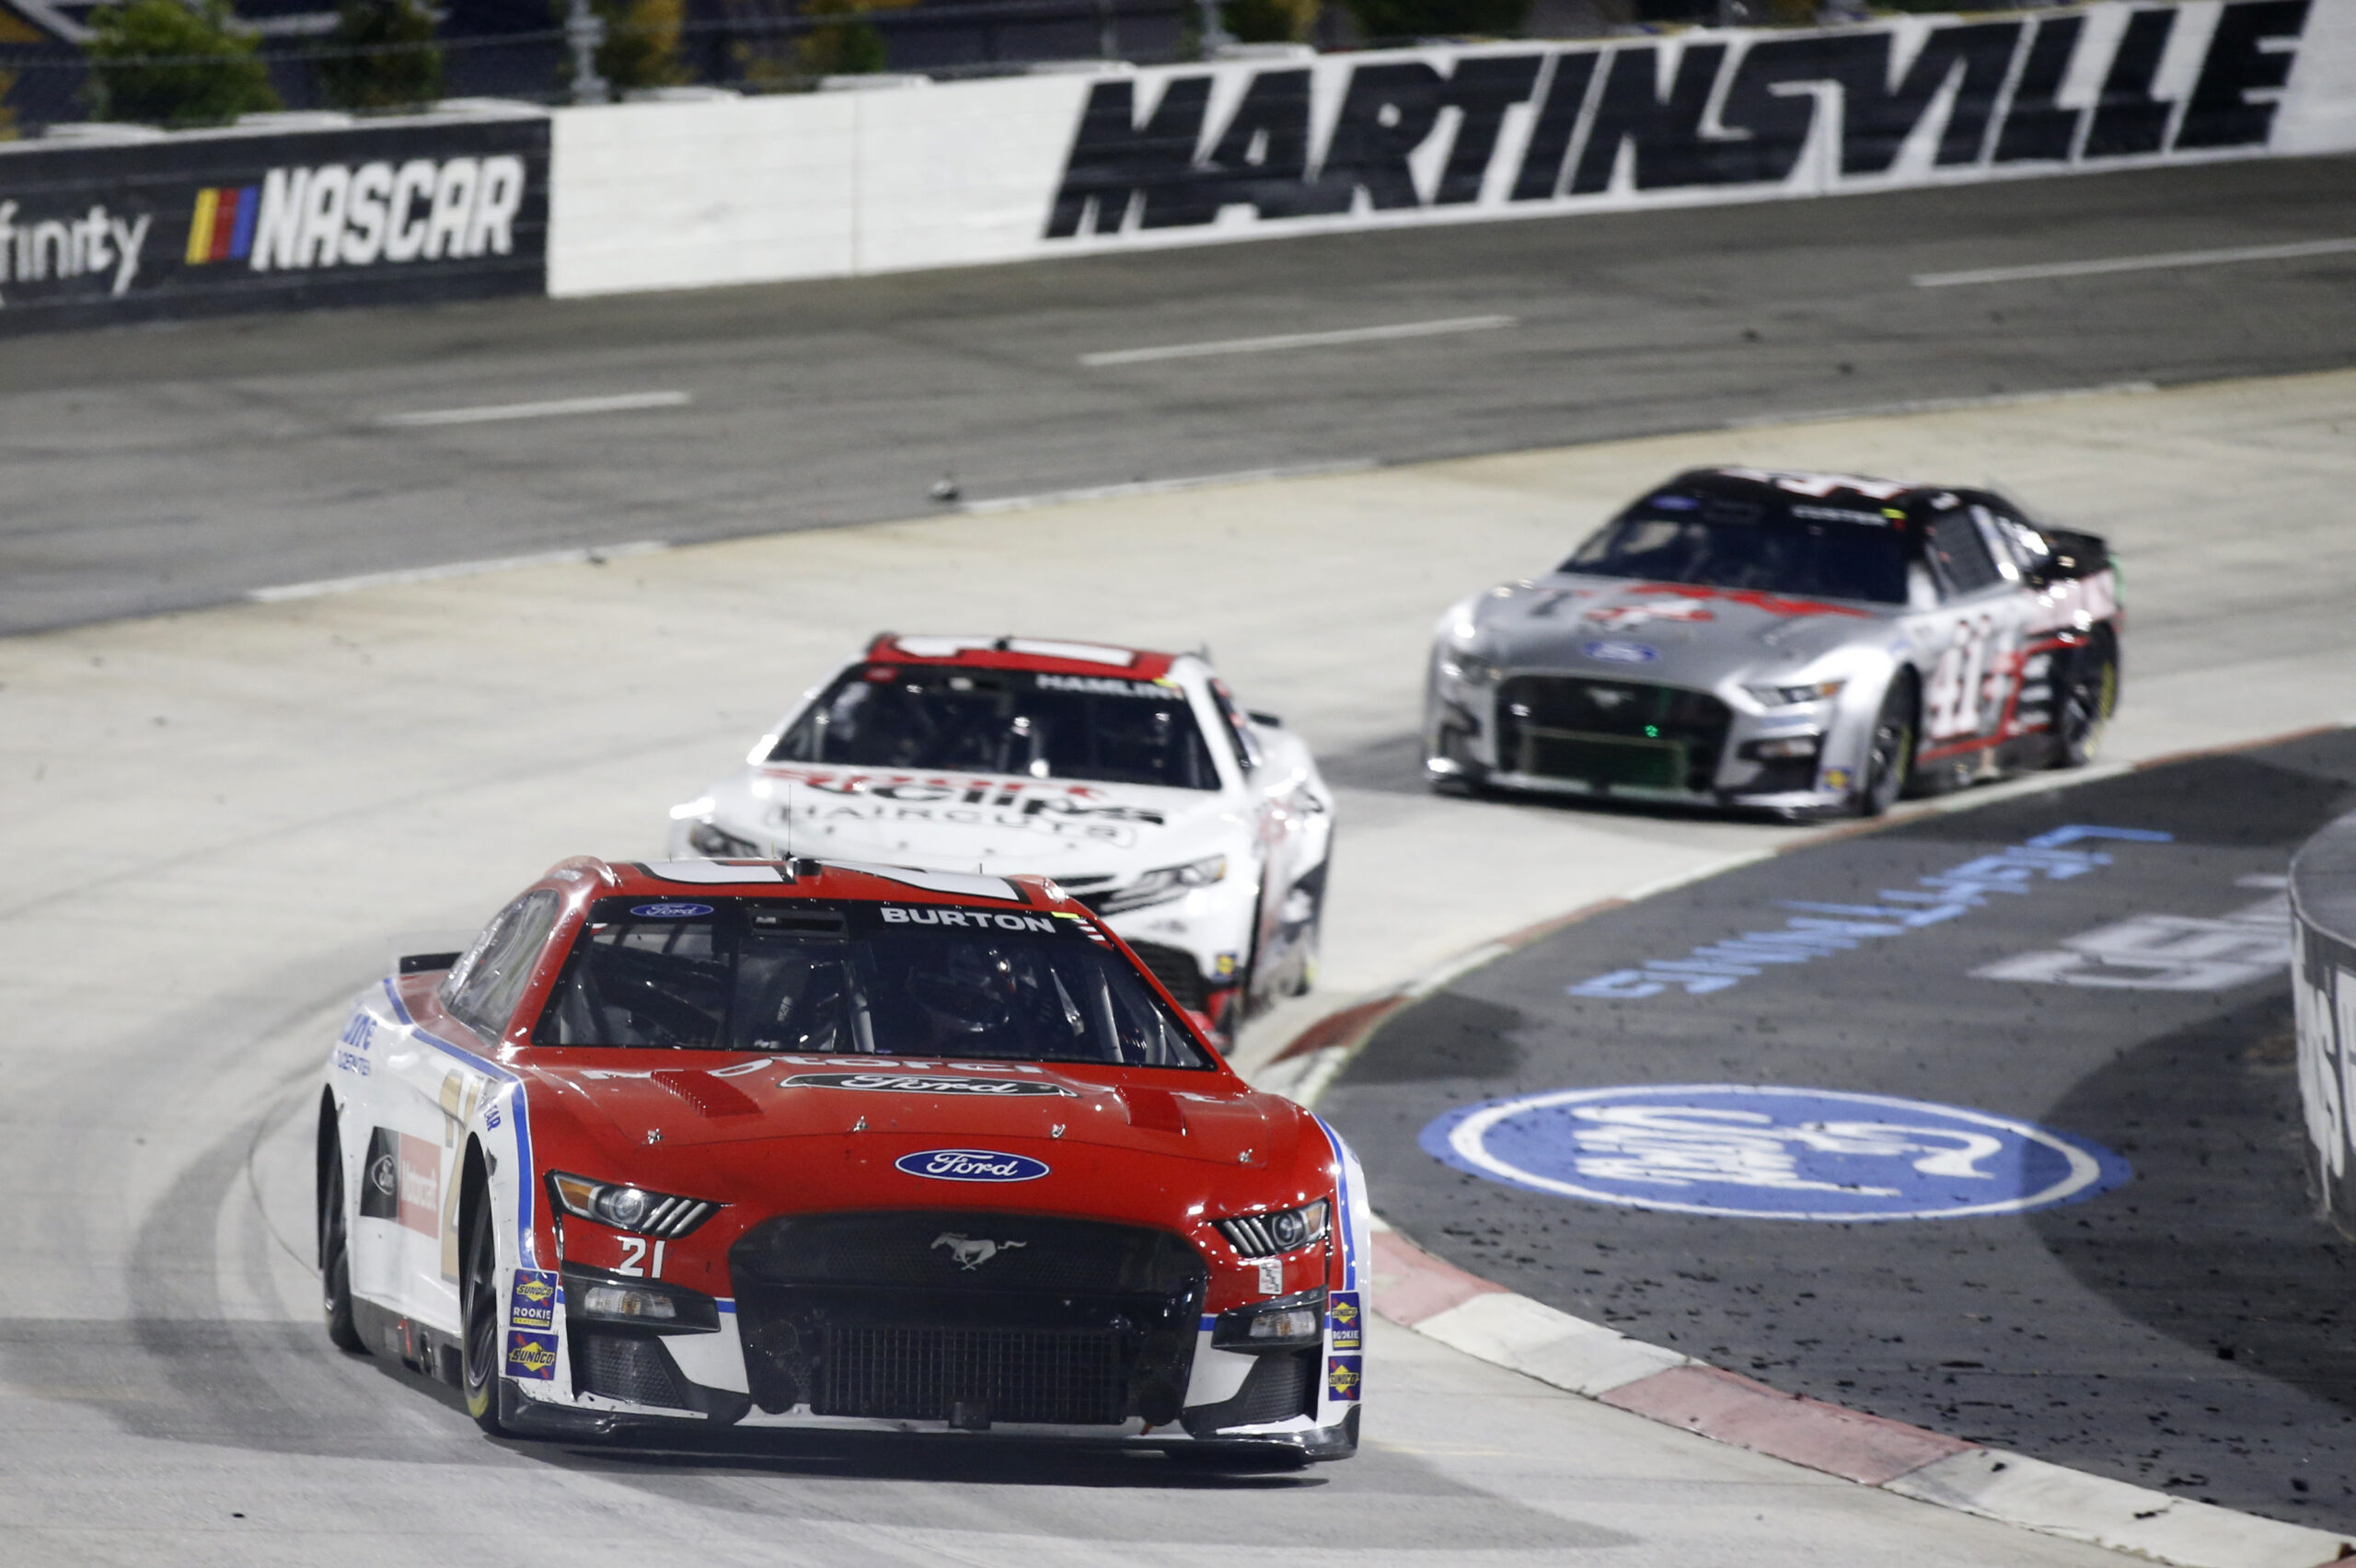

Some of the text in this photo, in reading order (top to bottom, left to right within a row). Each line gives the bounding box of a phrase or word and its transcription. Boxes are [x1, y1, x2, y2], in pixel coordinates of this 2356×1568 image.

[1041, 1, 2311, 240] MARTINSVILLE
[249, 154, 525, 272] NASCAR
[0, 198, 153, 299] finity
[646, 903, 699, 916] Ford
[880, 906, 1057, 934] BURTON
[838, 1073, 1019, 1093] Ford
[926, 1152, 1019, 1177] Ford
[618, 1237, 666, 1279] 21
[513, 1307, 551, 1320] ROOKIE
[511, 1349, 554, 1365] SUNOCO
